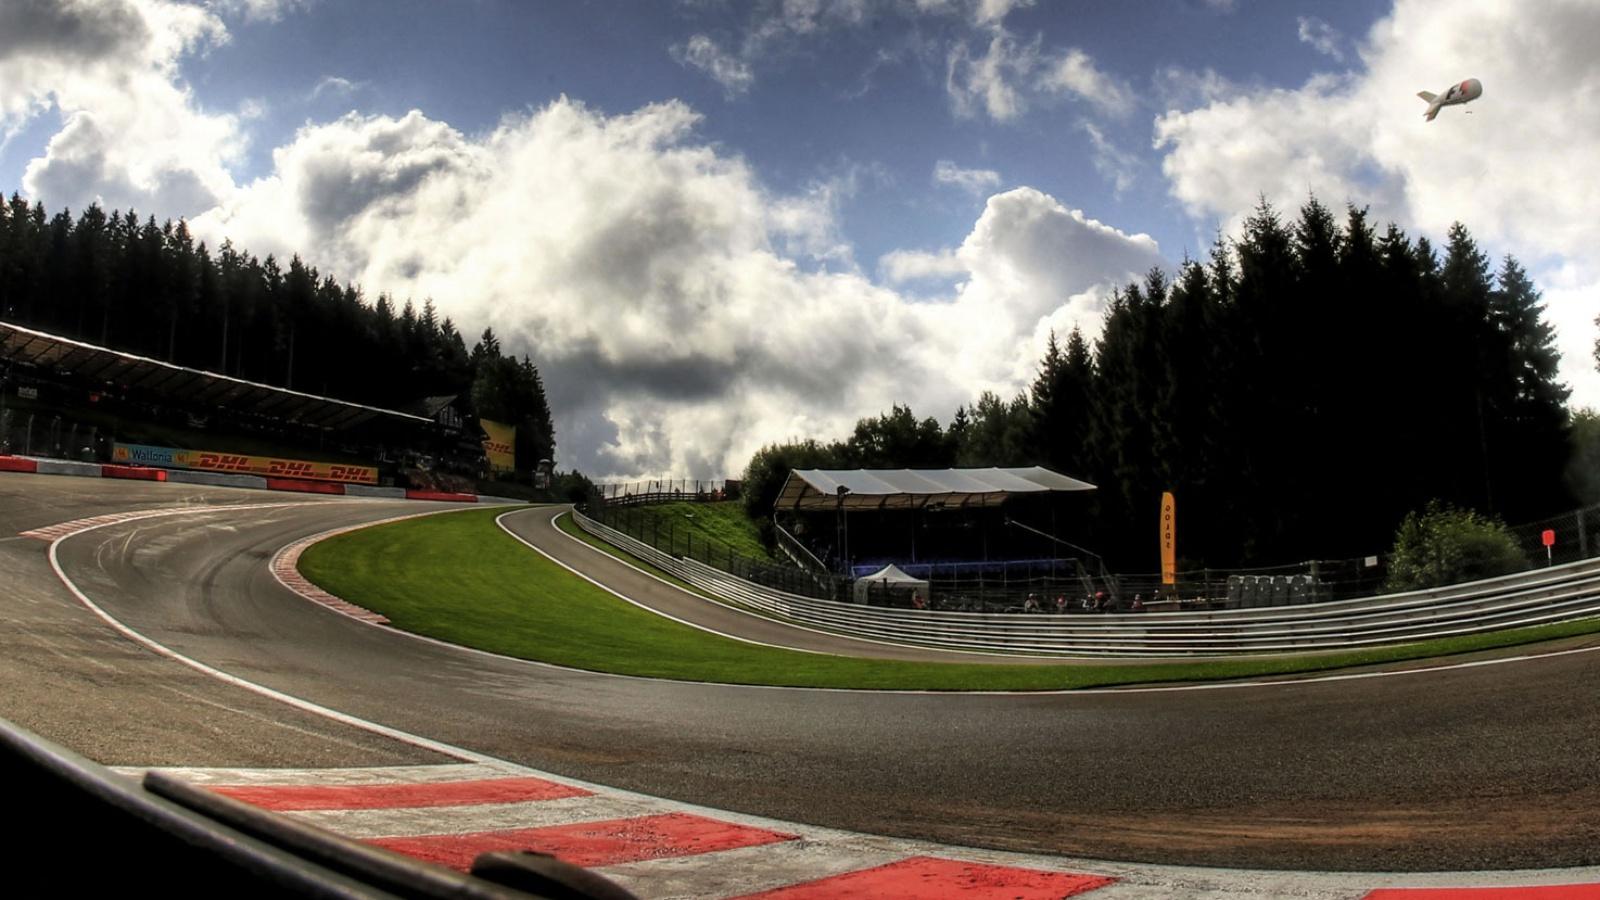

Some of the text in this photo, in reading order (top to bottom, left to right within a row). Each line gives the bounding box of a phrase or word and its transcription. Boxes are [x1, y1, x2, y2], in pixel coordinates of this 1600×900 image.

[131, 448, 173, 463] Wallonia
[484, 441, 513, 455] DHL
[199, 453, 251, 471] DHL
[268, 461, 315, 477] DHL
[329, 465, 371, 481] DHL
